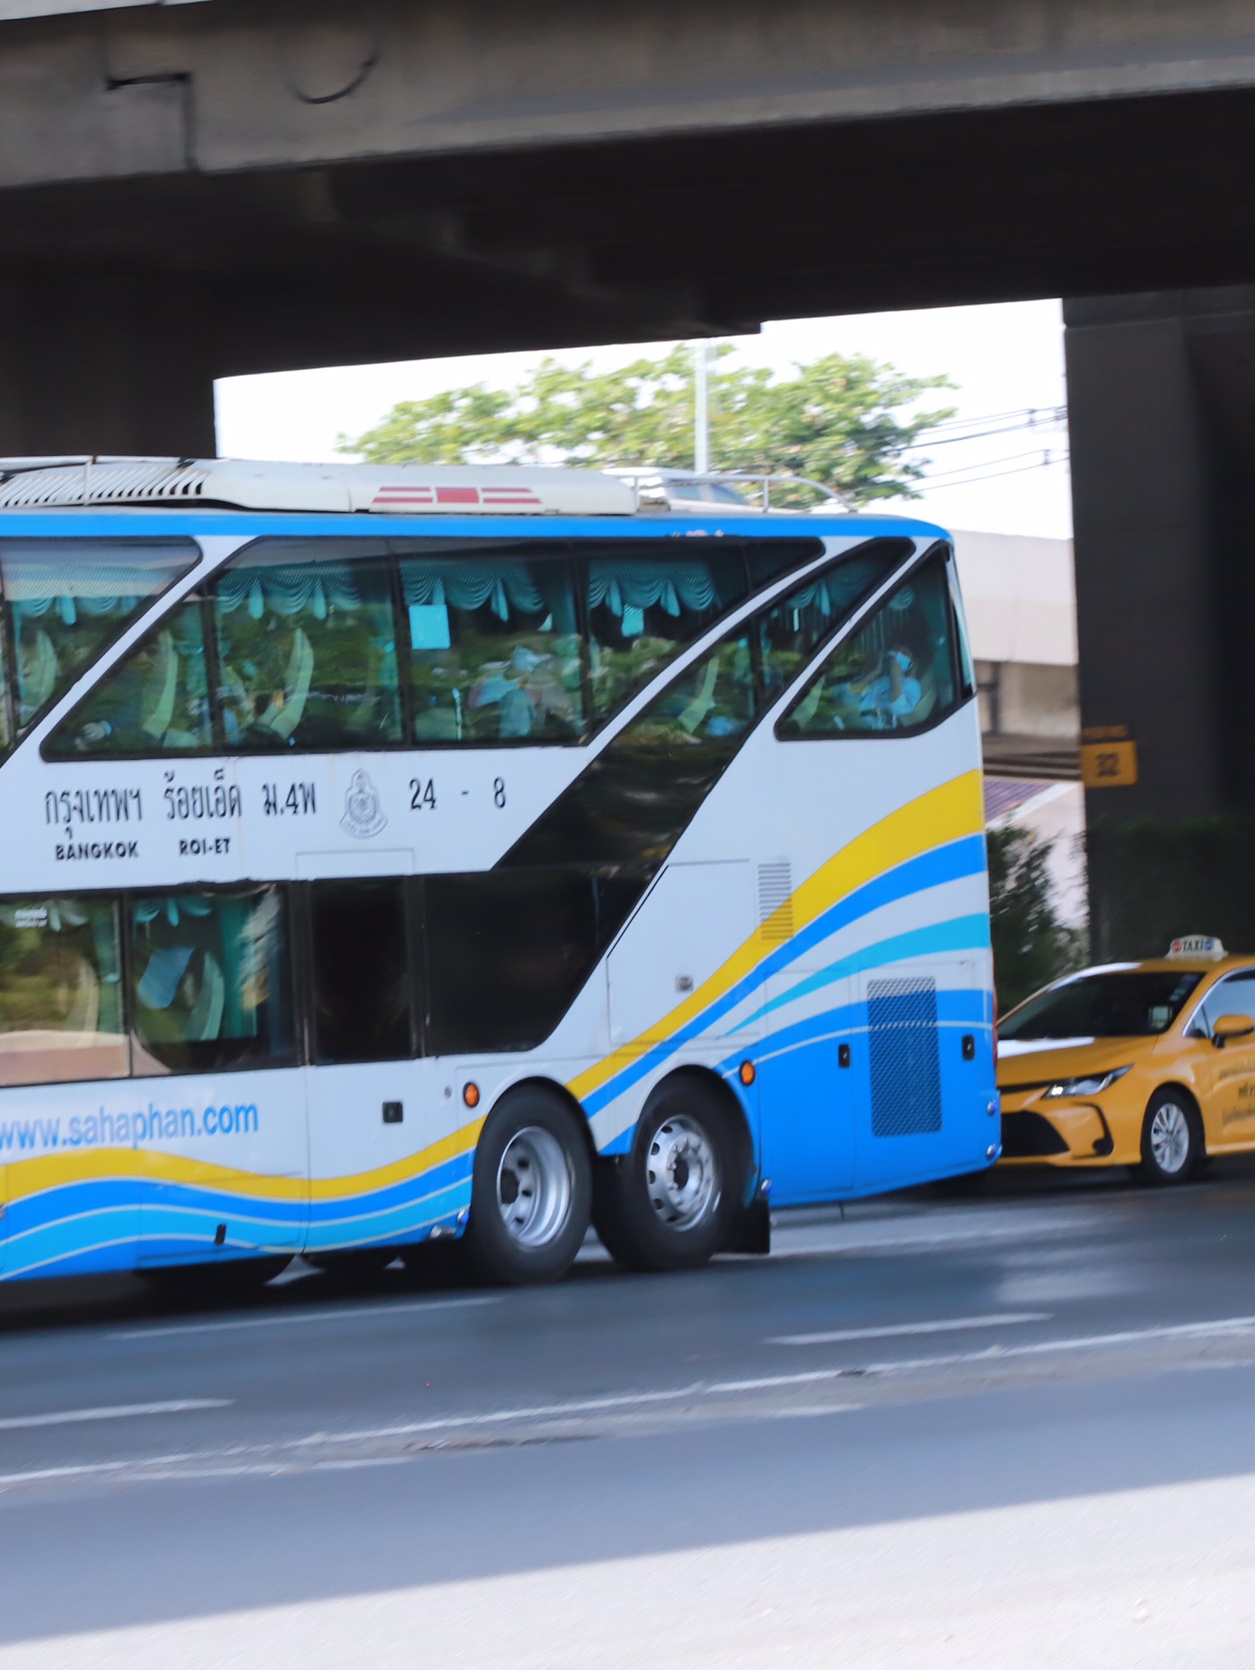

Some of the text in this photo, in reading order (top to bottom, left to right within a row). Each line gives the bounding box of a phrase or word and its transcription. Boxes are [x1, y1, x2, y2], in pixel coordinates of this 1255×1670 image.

[45, 788, 143, 840] กรุงเทพฯ
[163, 768, 243, 820] ร้อยเอ็ด
[408, 777, 437, 811] 24
[492, 776, 507, 809] 8
[55, 840, 139, 861] BANGKOK
[178, 837, 231, 856] ROI-ET
[1182, 940, 1204, 952] TAXI
